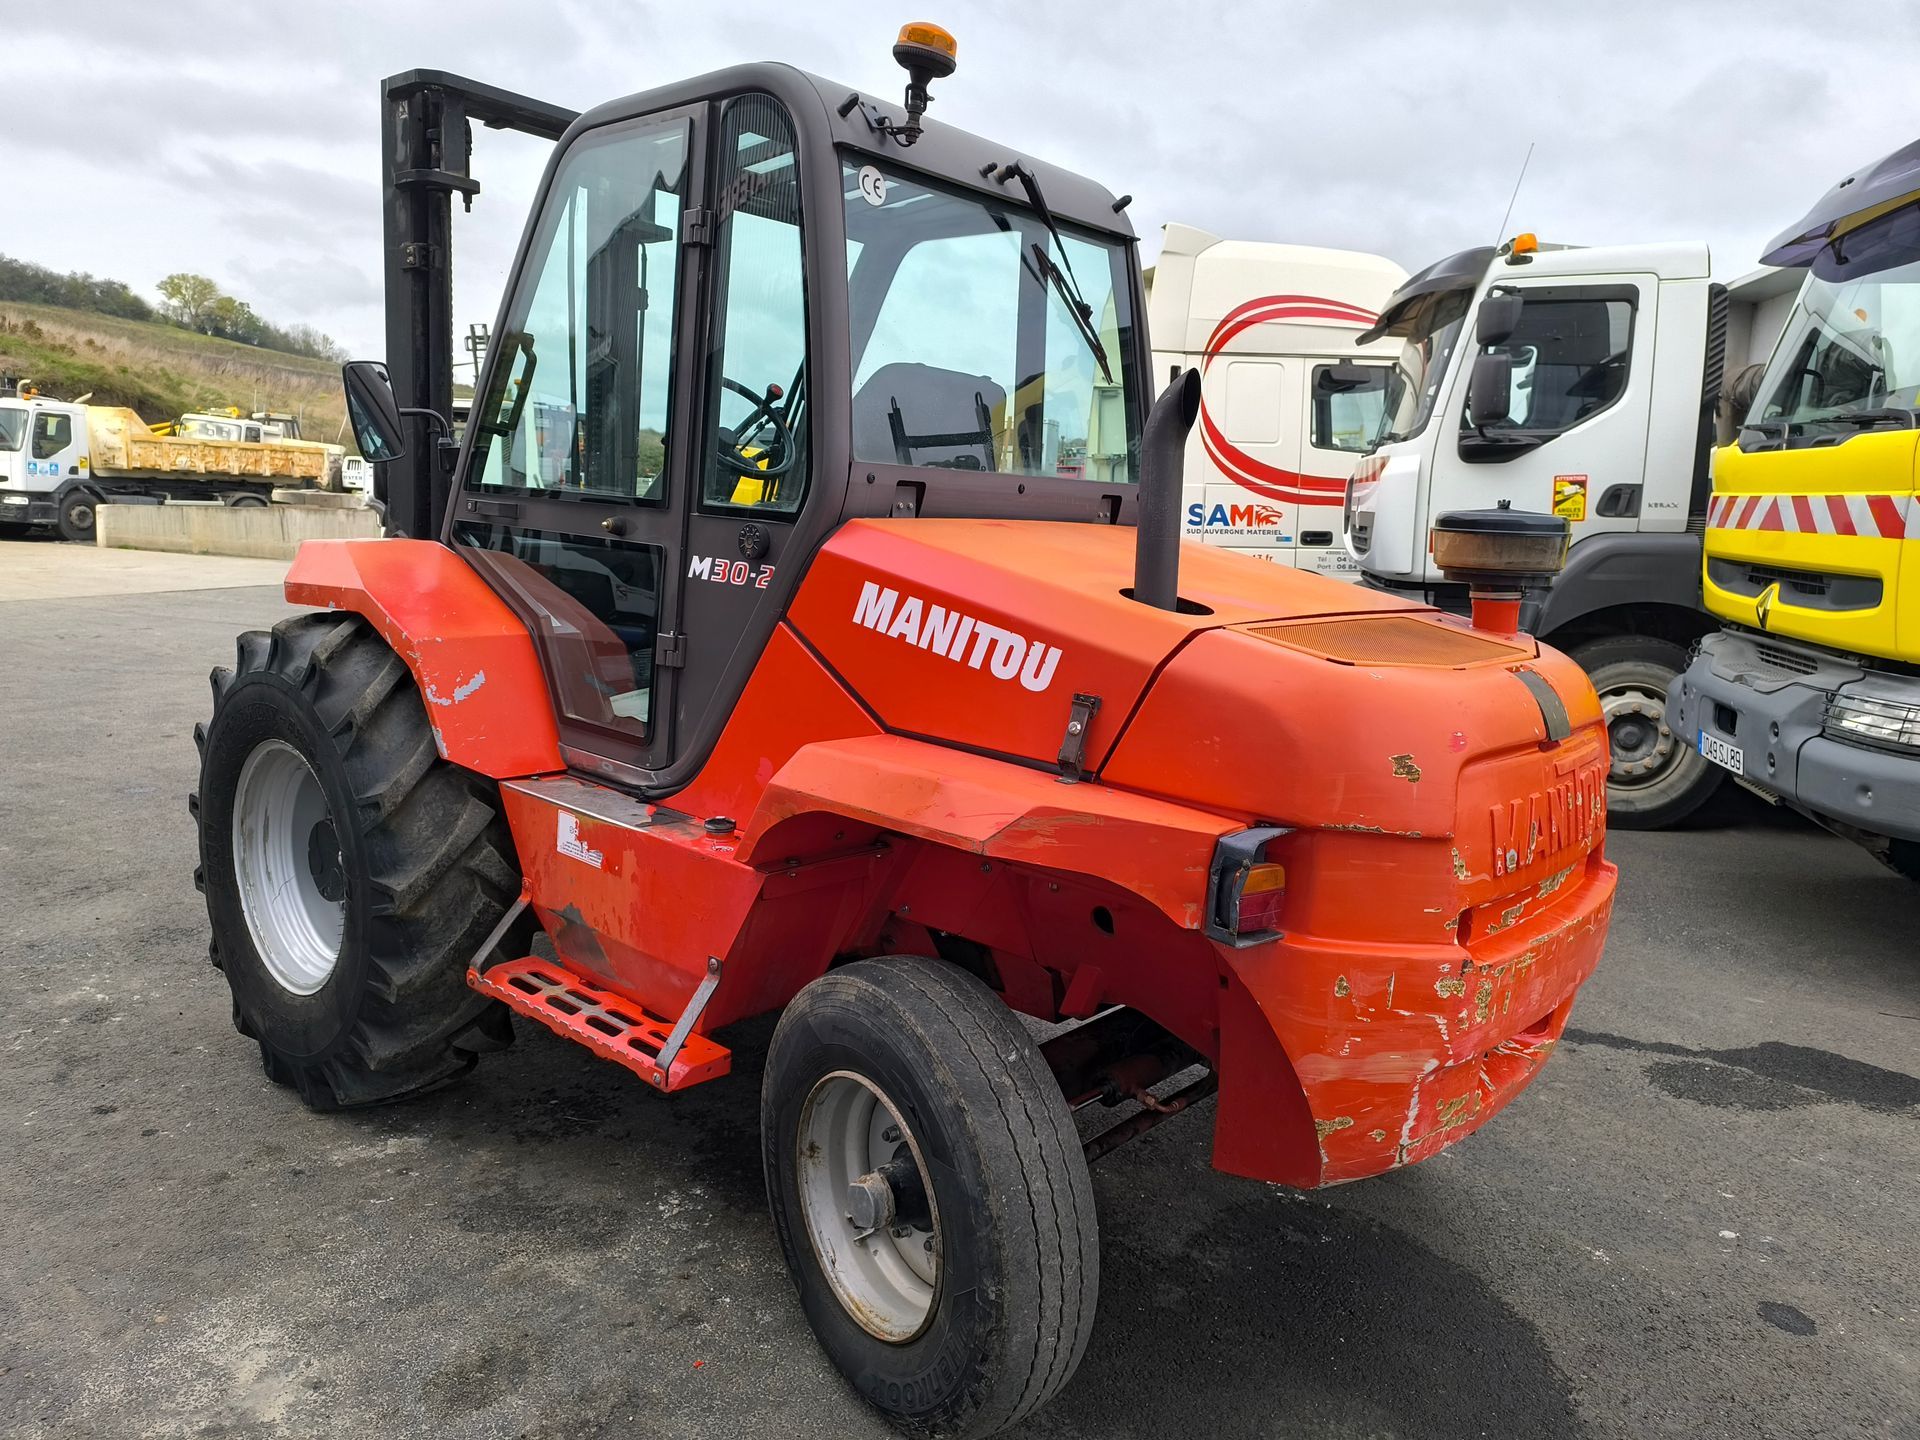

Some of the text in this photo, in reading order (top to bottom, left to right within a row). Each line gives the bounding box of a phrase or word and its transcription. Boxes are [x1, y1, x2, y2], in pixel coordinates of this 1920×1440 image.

[862, 174, 882, 199] CE
[1187, 503, 1254, 526] SAM
[1647, 502, 1679, 510] KERAX
[852, 580, 1063, 692] MANITOU
